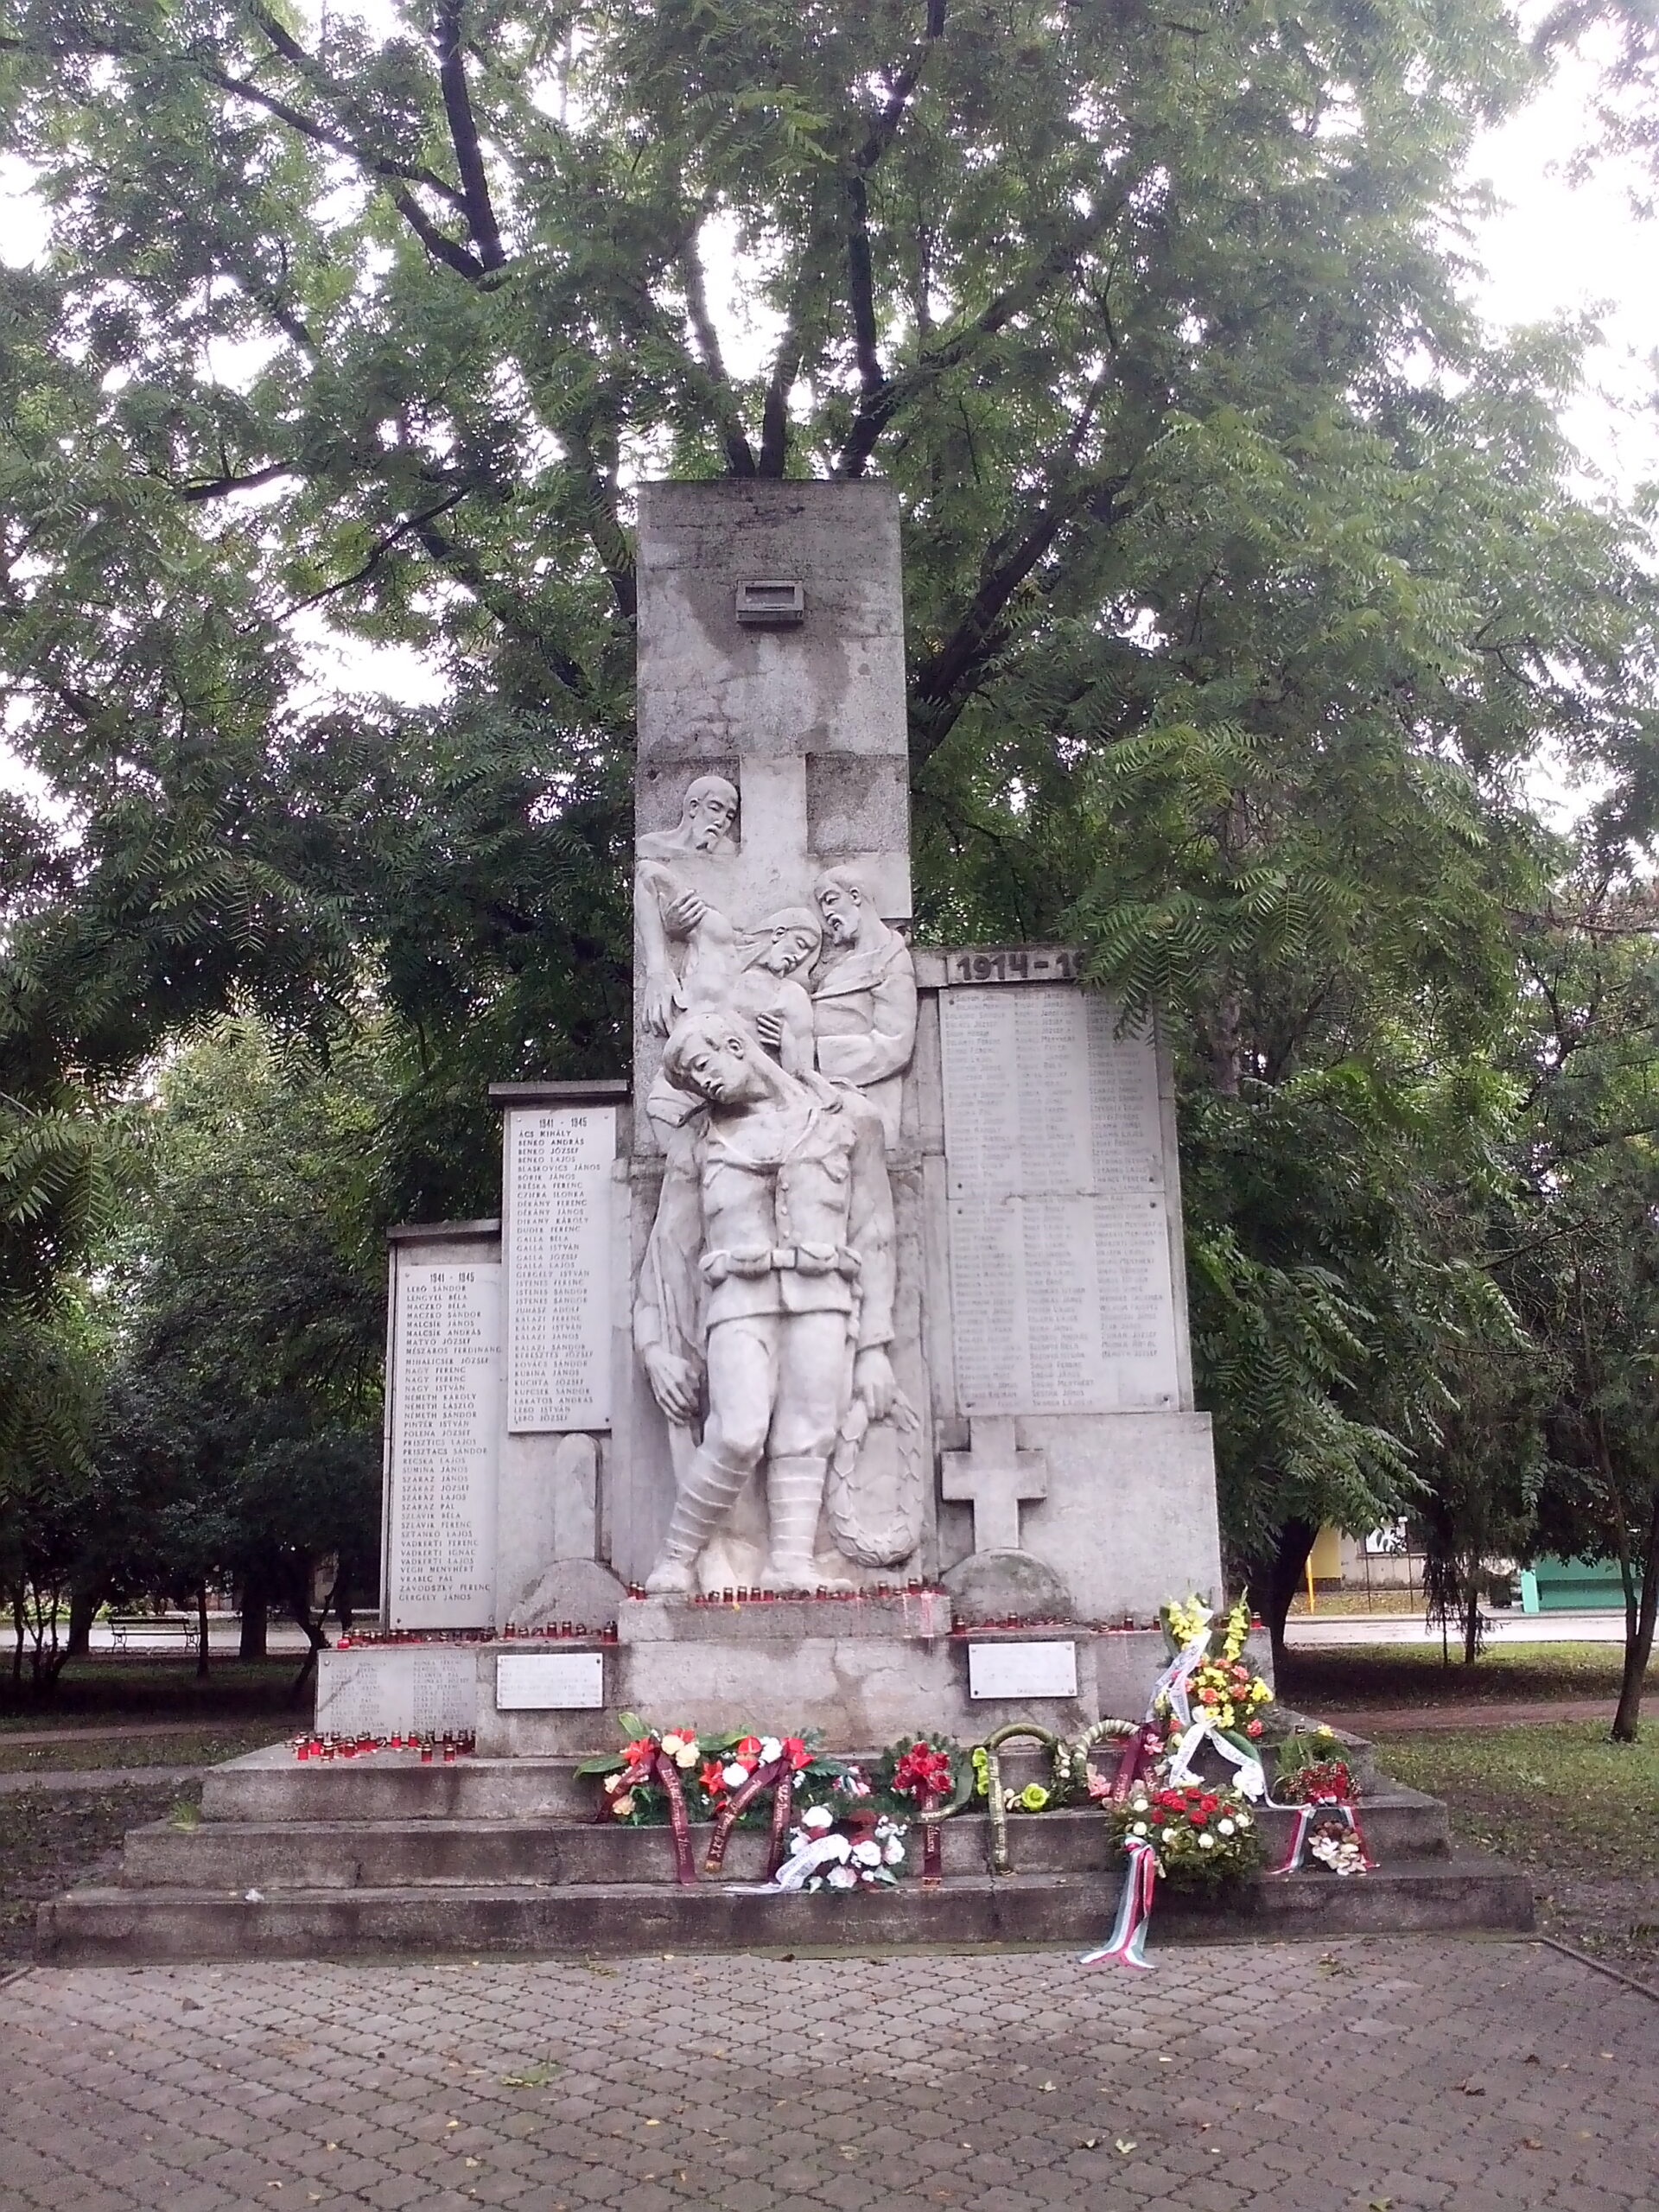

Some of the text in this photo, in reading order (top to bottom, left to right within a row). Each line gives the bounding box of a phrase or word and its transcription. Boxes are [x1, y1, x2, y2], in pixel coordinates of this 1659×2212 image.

[540, 1129, 572, 1137] MIHÁLY
[551, 1137, 585, 1145] ANDRÁS
[430, 1273, 445, 1283] 1941
[459, 1272, 475, 1283] 1945
[540, 1405, 571, 1413] ISTVÁN
[443, 1410, 477, 1418] SÁNDOR
[443, 1593, 471, 1601] JÁNOS
